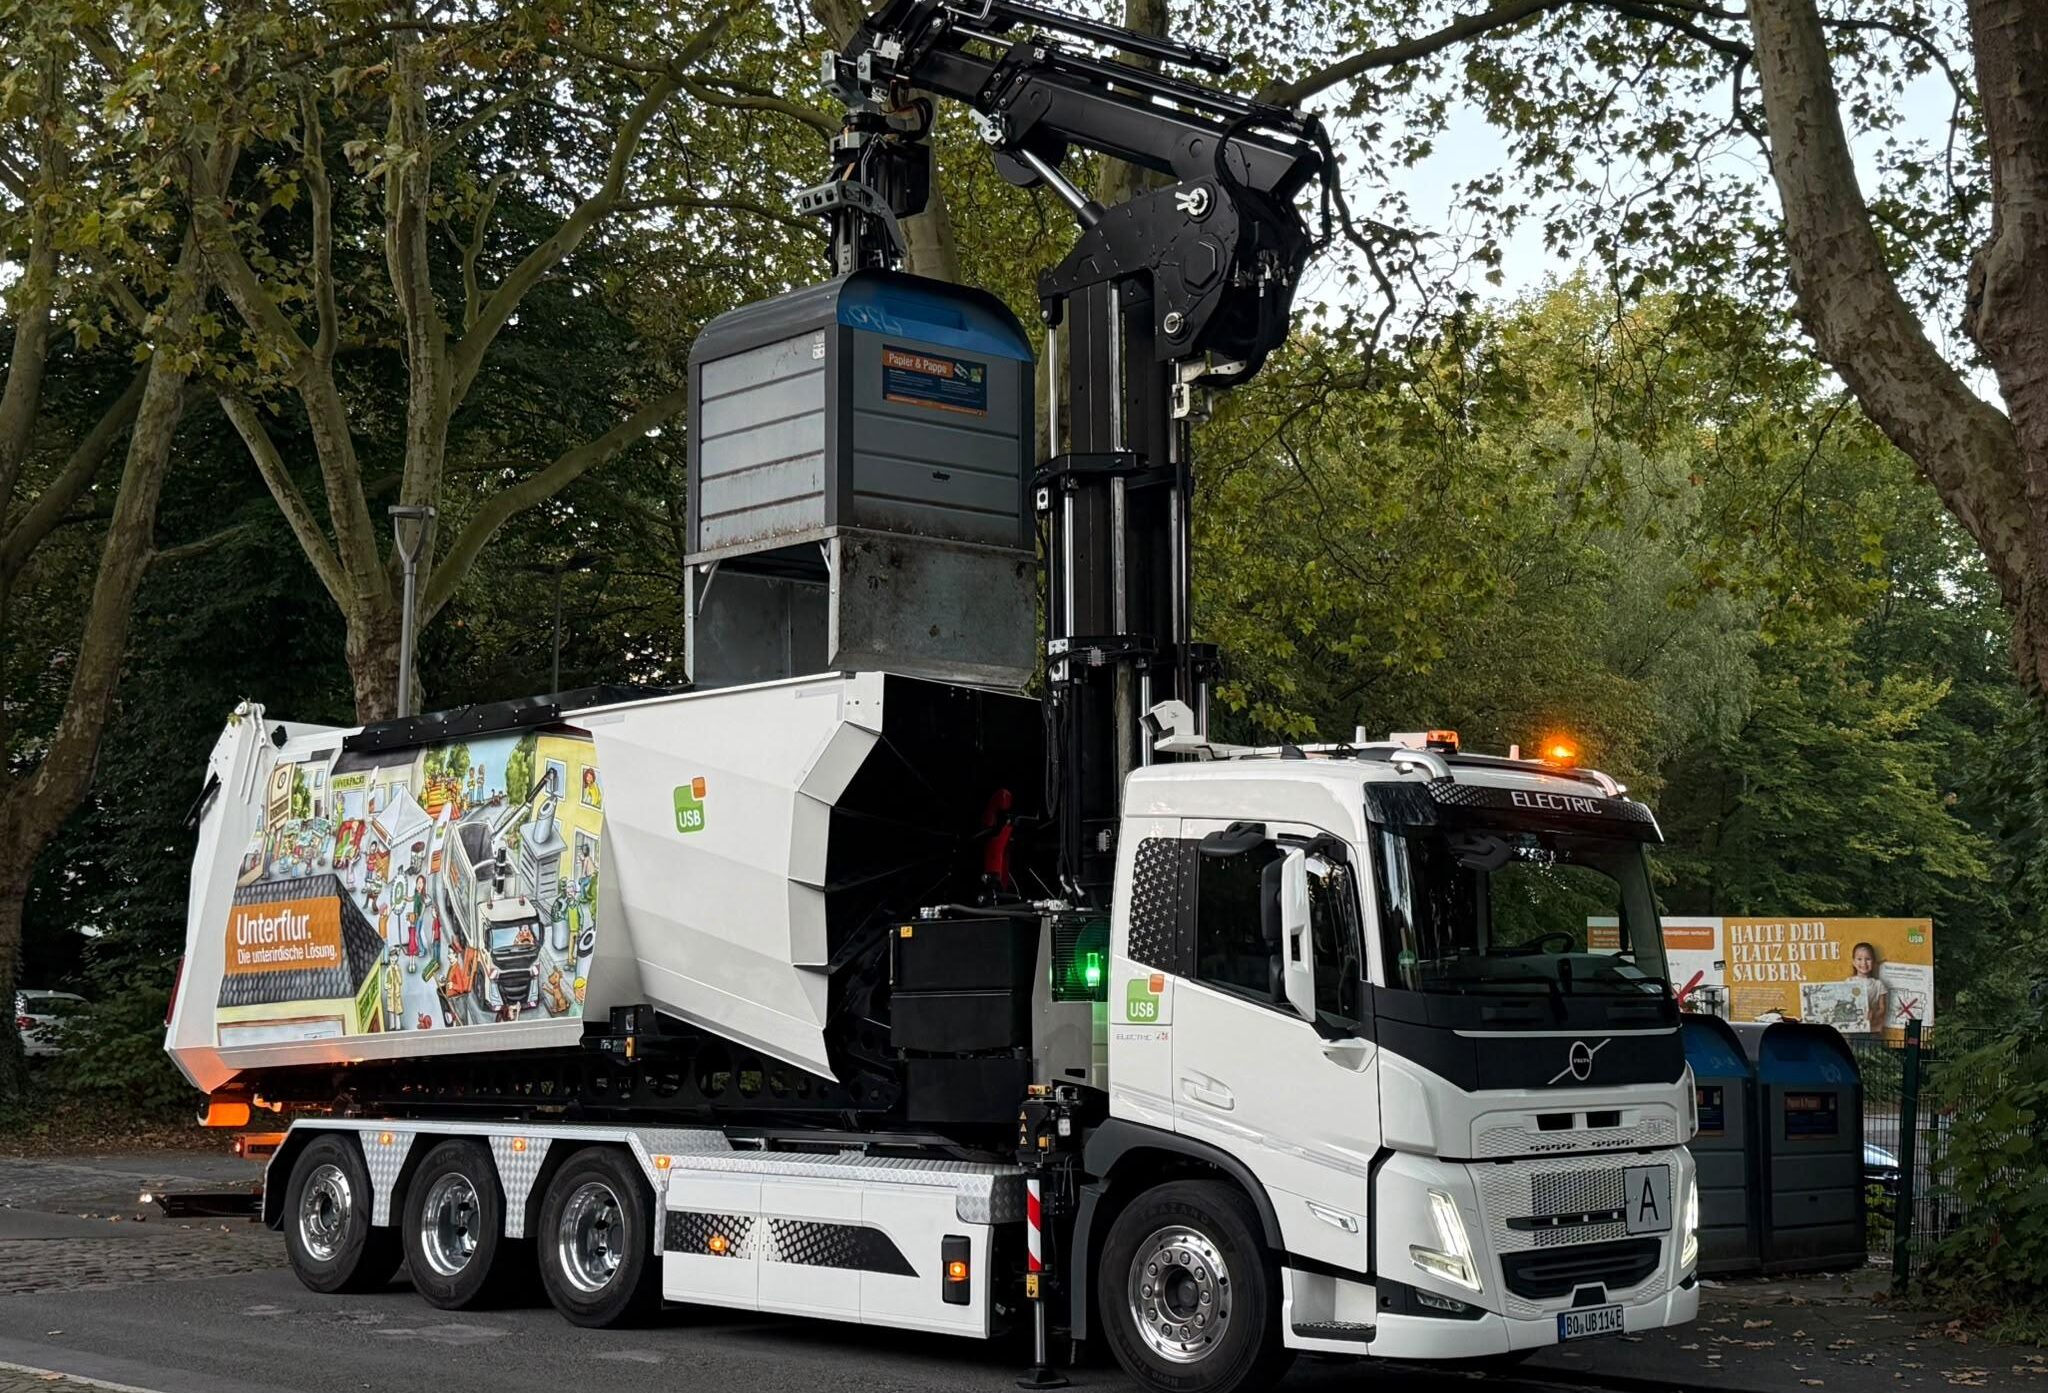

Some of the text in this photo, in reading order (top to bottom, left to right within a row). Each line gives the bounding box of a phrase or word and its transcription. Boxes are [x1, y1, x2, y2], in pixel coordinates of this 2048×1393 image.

[888, 351, 947, 375] Papier & Pappe
[1510, 791, 1603, 815] ELECTRIC
[678, 809, 702, 828] USB
[236, 909, 312, 946] Unterflur.
[1730, 921, 1826, 944] HALTE DEN
[237, 942, 338, 965] Die unterirdische Lösung.
[1731, 941, 1841, 963] PLATZ BITTE
[1732, 962, 1808, 983] SAUBER.
[1129, 1001, 1155, 1018] USB
[1638, 1174, 1660, 1223] A
[1566, 1315, 1580, 1336] BO
